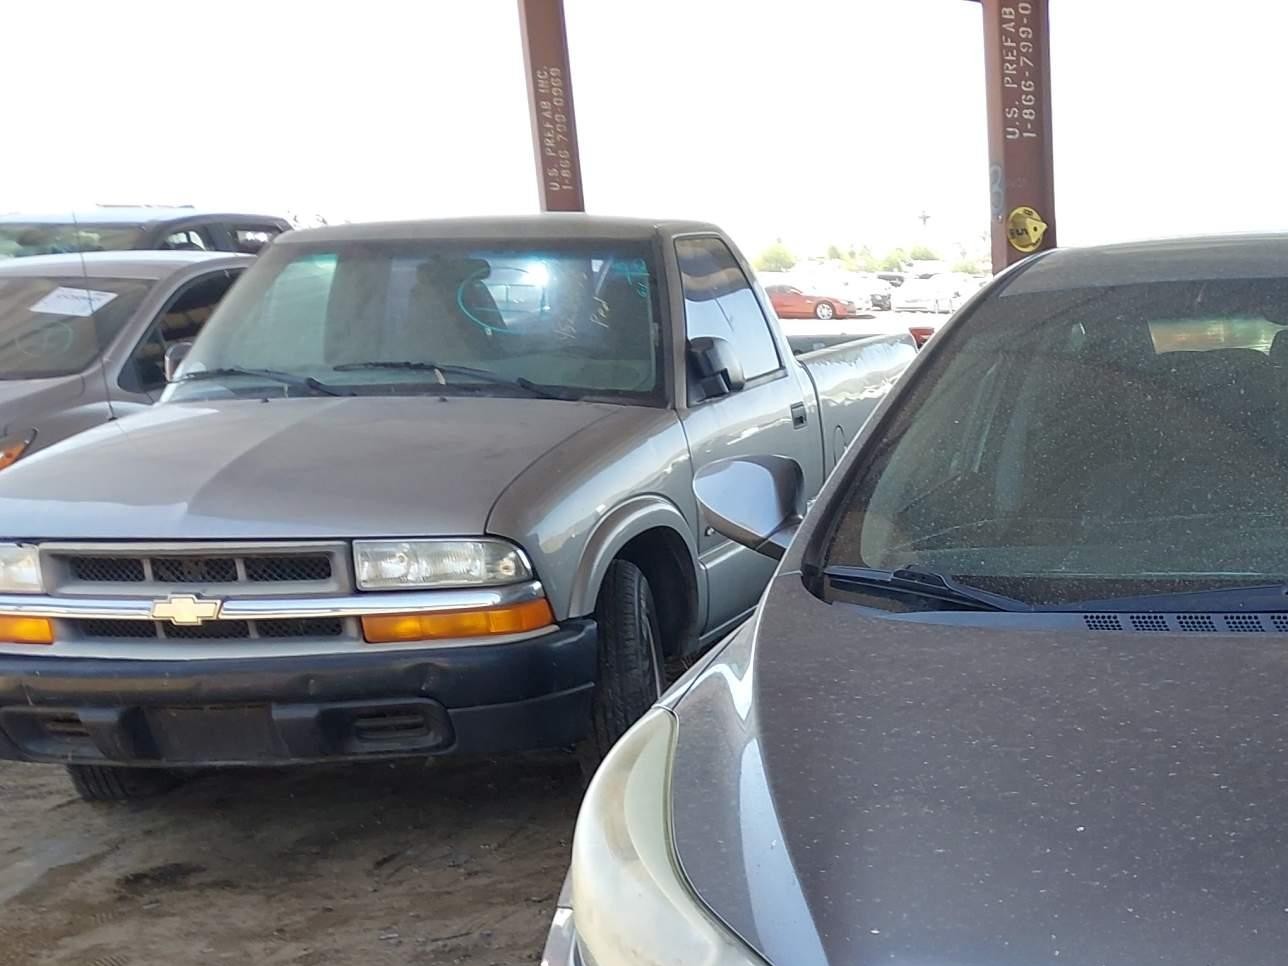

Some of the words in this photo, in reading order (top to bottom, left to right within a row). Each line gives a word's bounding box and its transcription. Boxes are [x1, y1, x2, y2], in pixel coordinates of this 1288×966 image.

[1001, 7, 1018, 88] PREFAB
[540, 101, 557, 157] PREFAB
[1005, 101, 1020, 139] U.S.
[547, 168, 561, 191] U.S.
